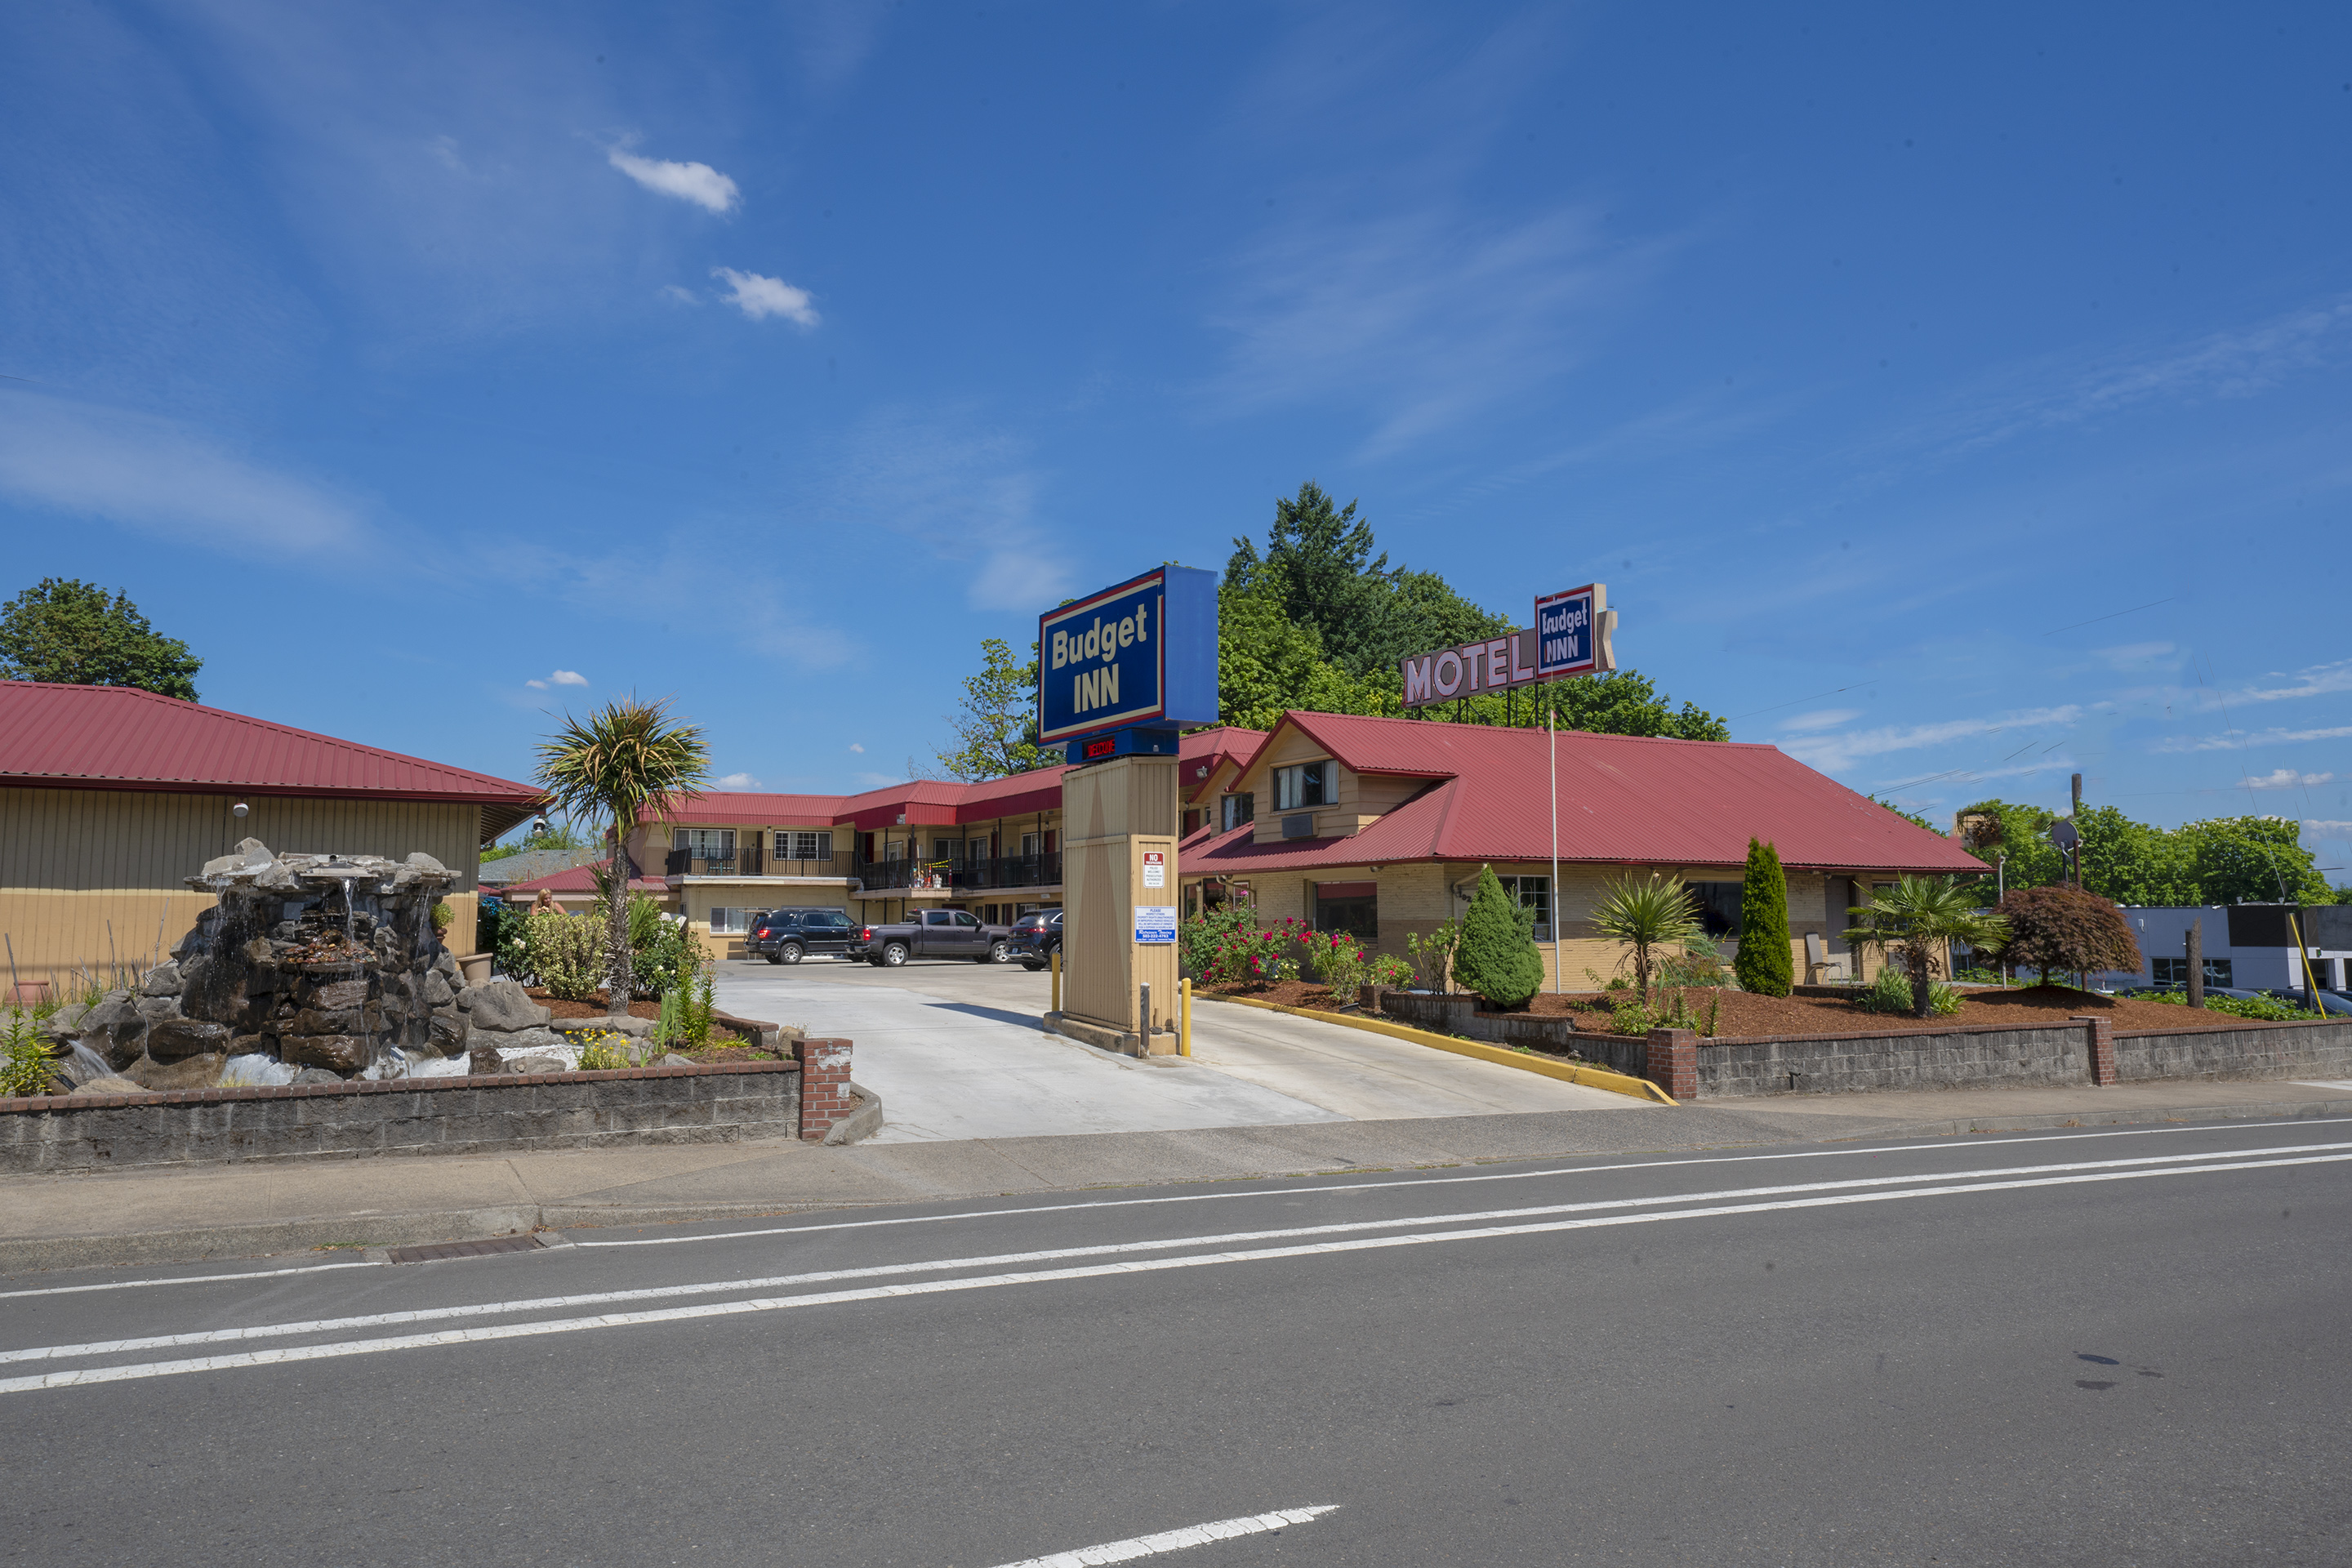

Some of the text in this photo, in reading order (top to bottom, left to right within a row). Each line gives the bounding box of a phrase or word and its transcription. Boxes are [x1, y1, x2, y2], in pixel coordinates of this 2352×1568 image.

[1052, 603, 1147, 670] Budget
[1405, 633, 1535, 704] MOTEL
[1074, 662, 1120, 714] INN
